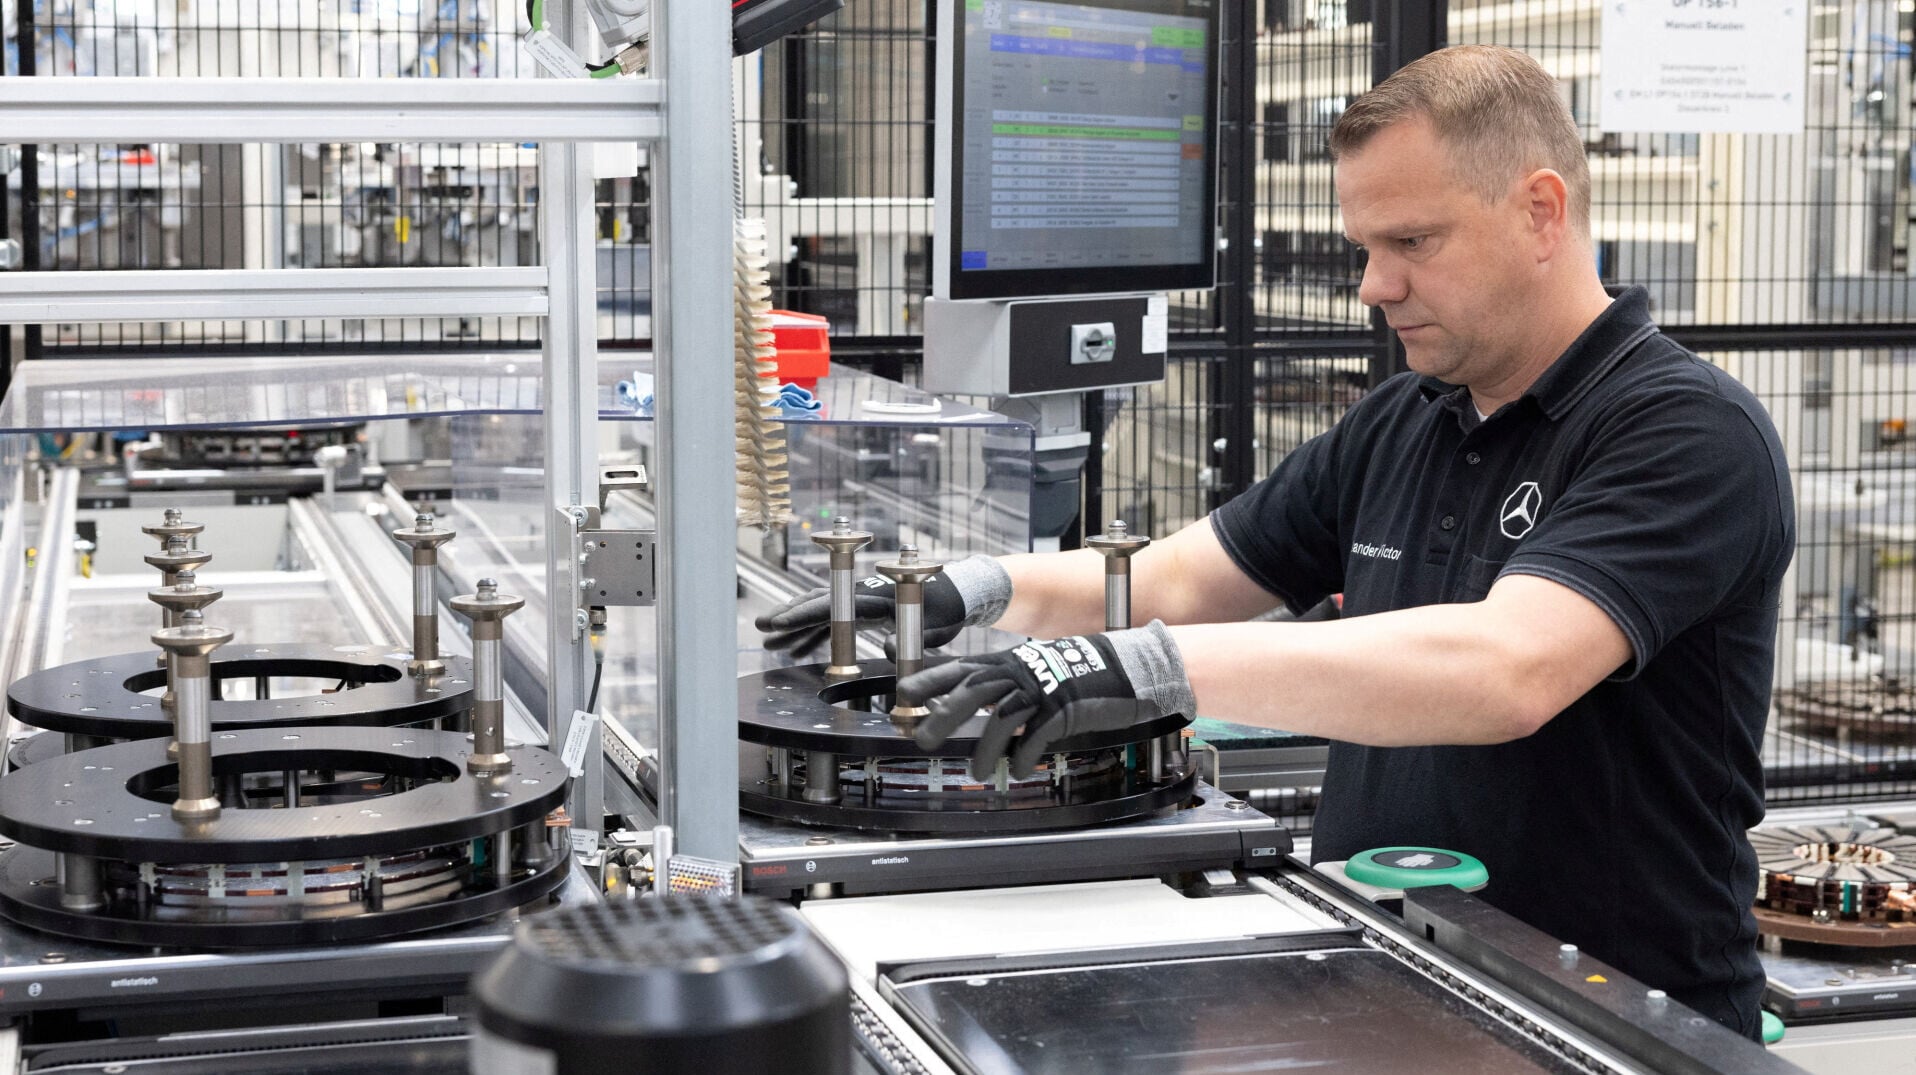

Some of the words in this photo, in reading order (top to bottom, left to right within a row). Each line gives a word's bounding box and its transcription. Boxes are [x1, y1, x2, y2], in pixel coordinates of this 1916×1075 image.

[1351, 542, 1379, 558] ander
[1012, 644, 1059, 696] uvex
[871, 856, 910, 865] antistatisch
[752, 865, 788, 876] BOSCH
